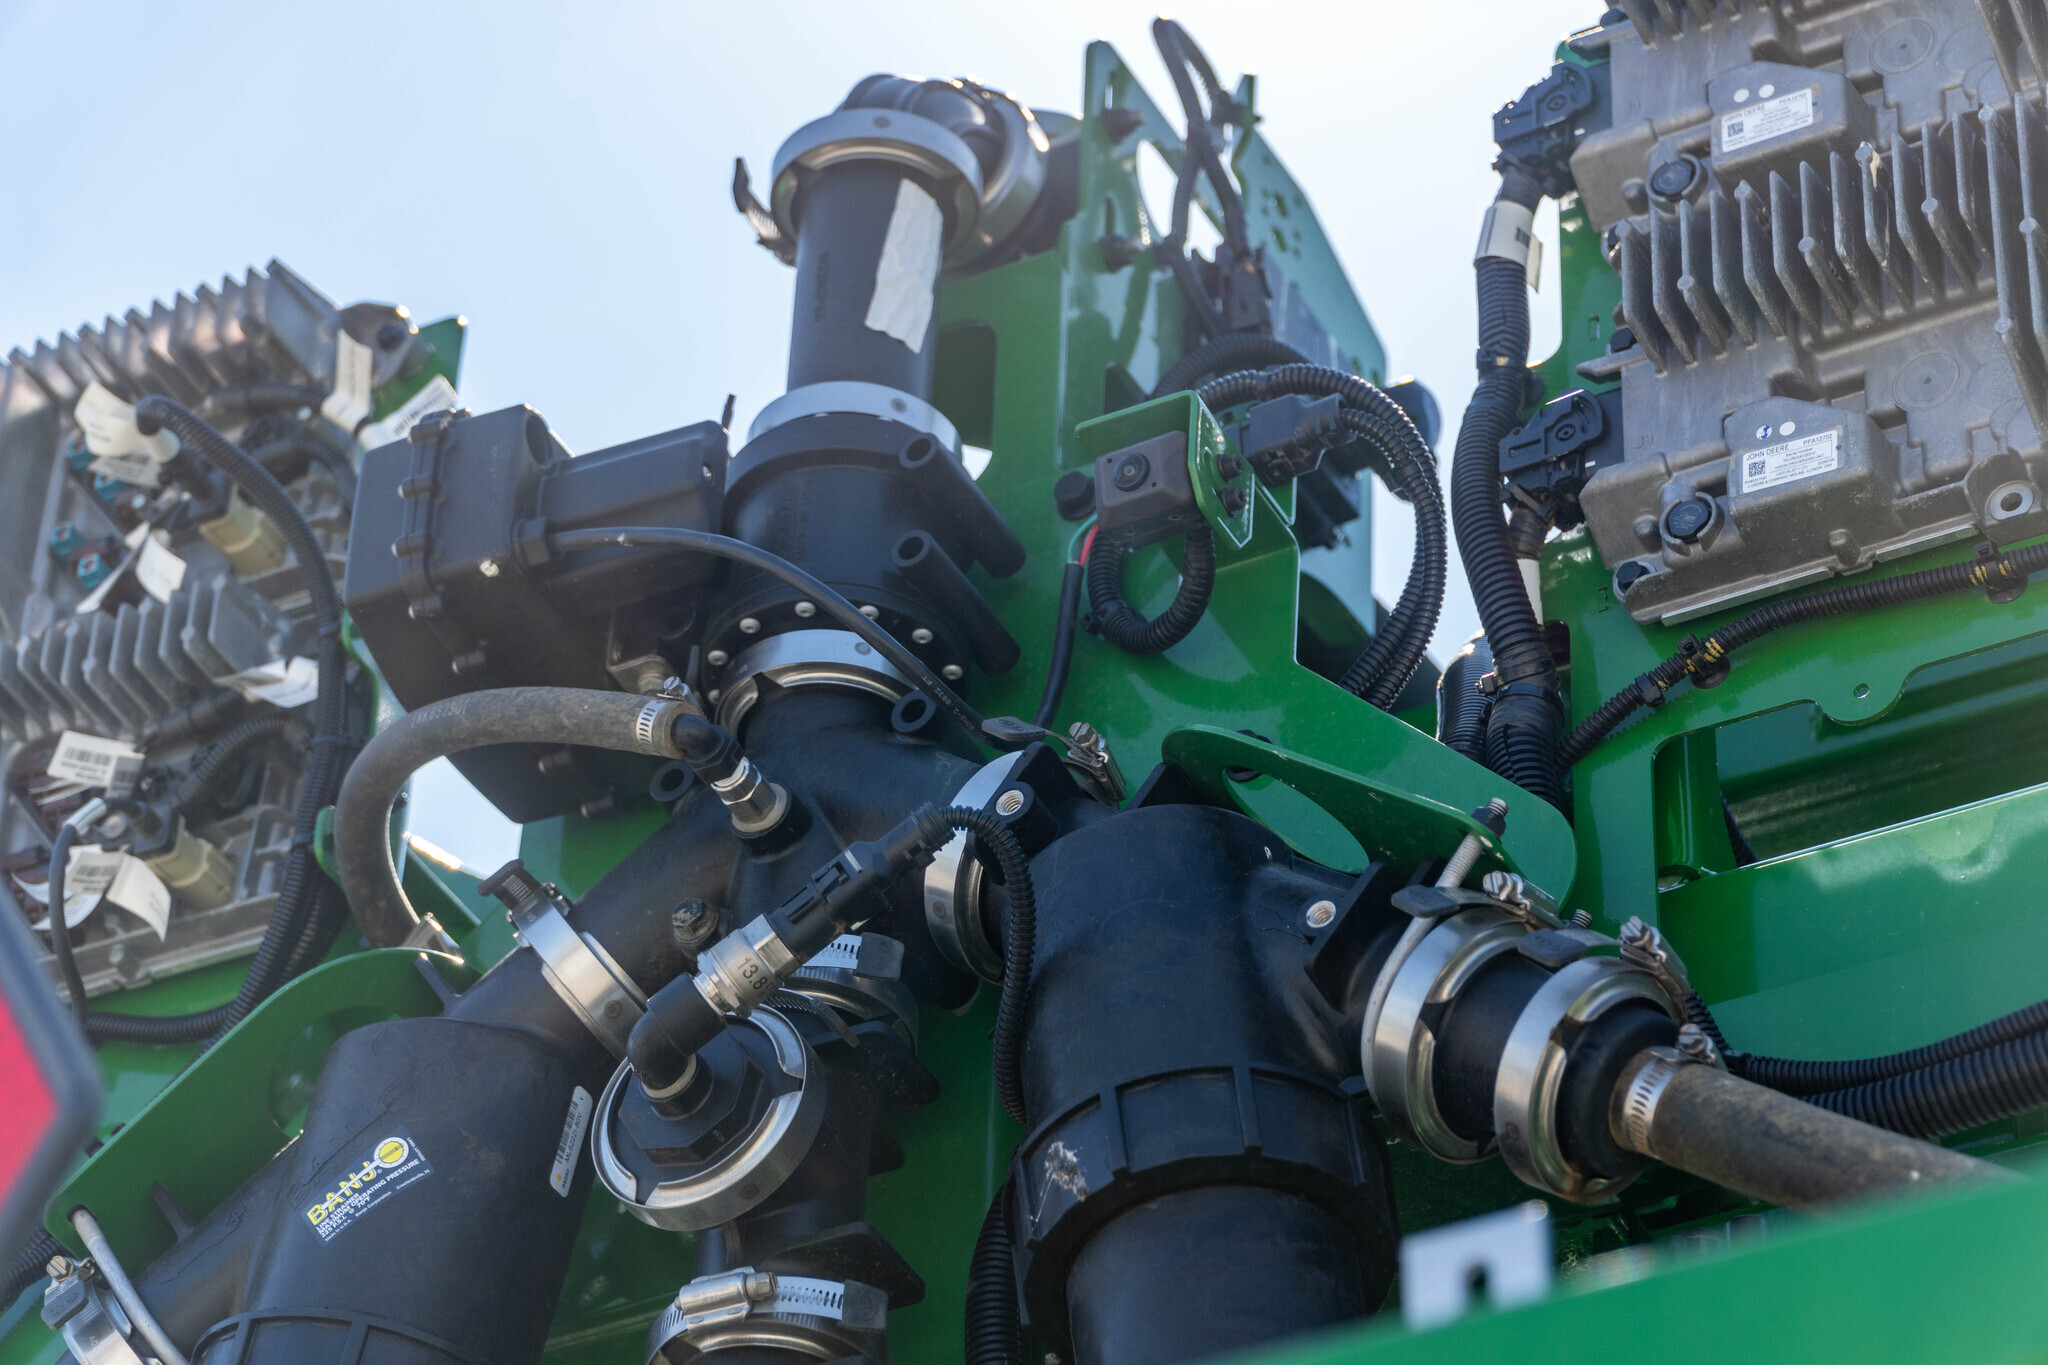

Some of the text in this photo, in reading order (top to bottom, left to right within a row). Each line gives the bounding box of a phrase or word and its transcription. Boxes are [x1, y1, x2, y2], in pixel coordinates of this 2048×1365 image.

[1746, 443, 1790, 461] JOHN DEERE
[1803, 433, 1833, 446] PFA12702
[922, 675, 933, 686] FT
[307, 1137, 409, 1226] BANJO
[318, 1159, 420, 1234] MAXIMUM OPERATING PRESSURE
[316, 1193, 360, 1231] LINE STRAINER
